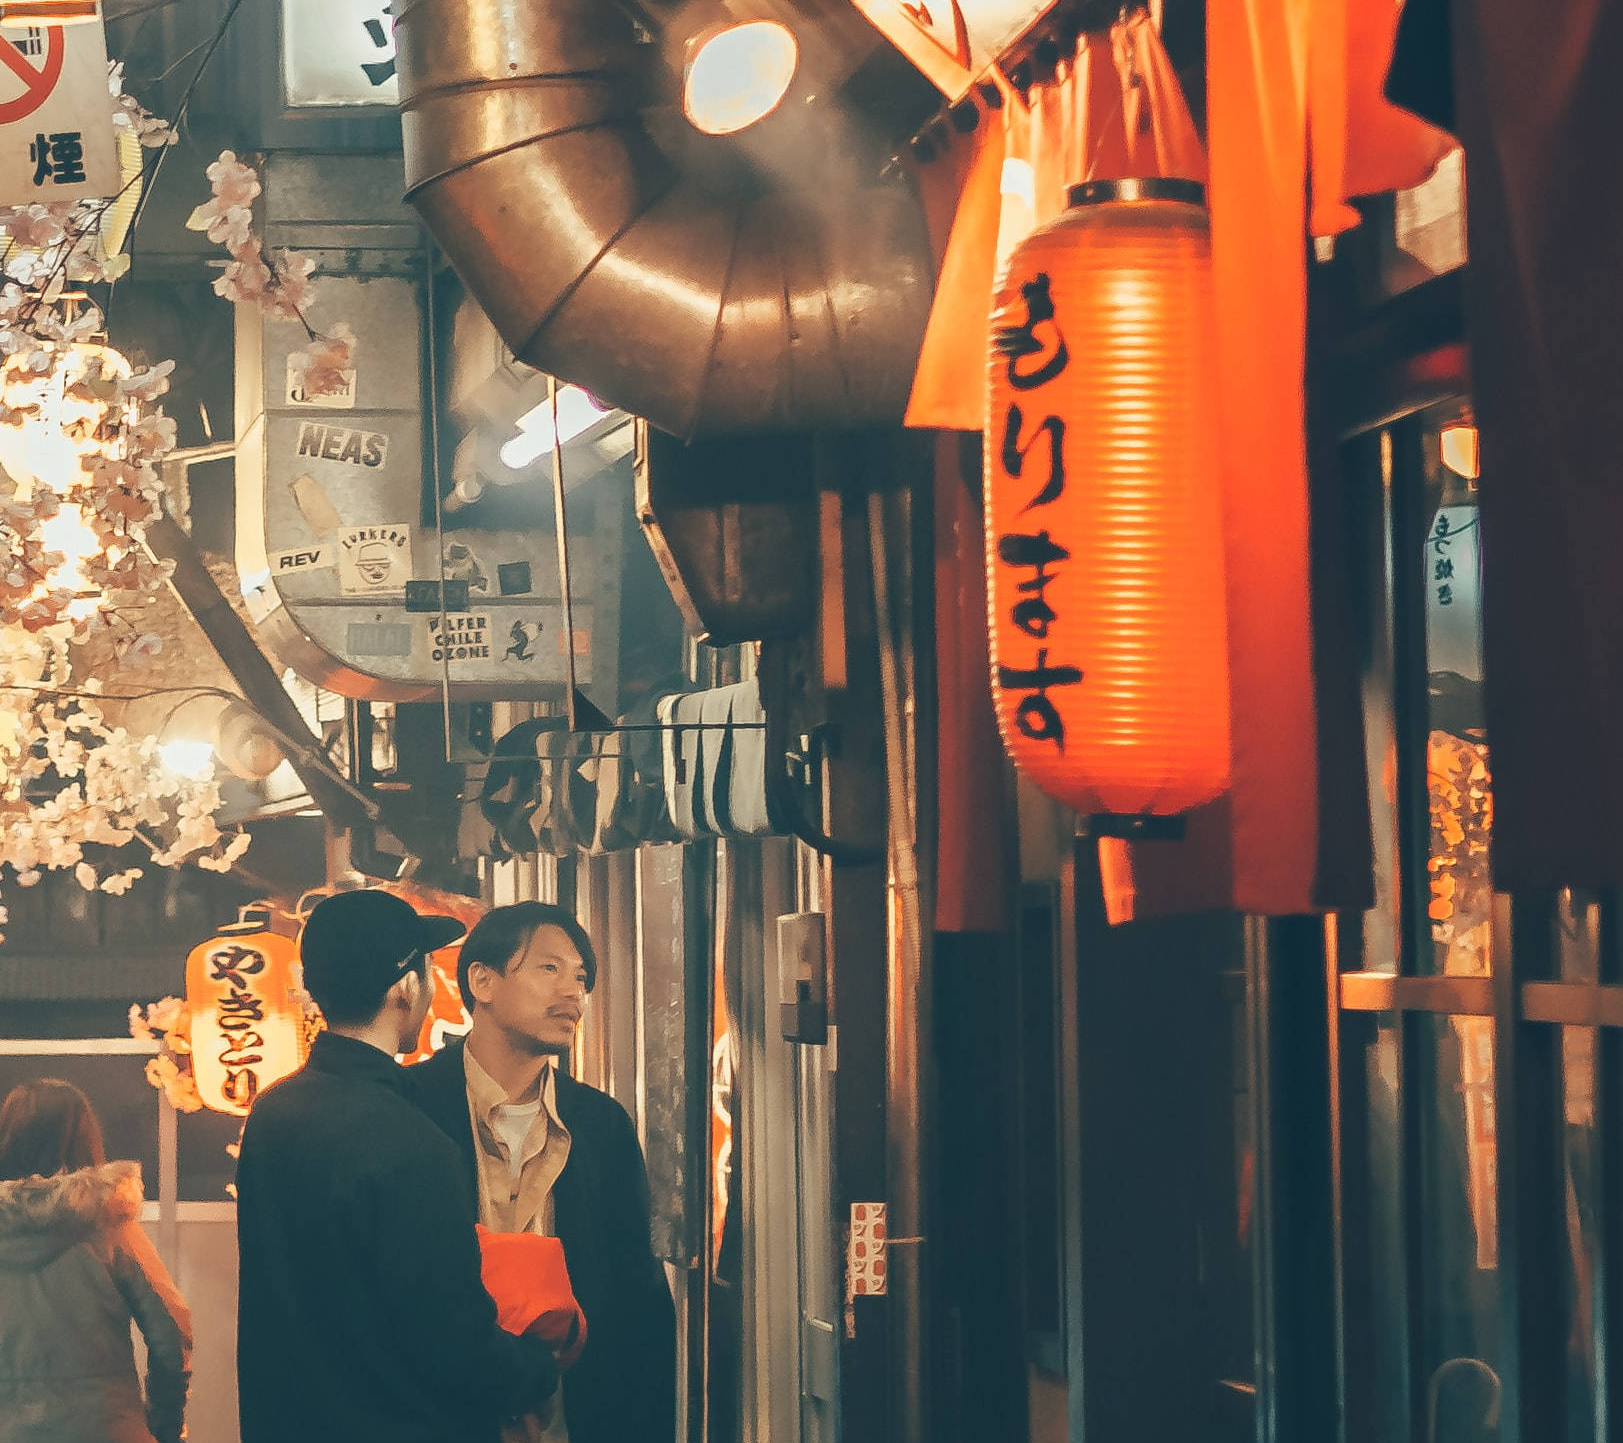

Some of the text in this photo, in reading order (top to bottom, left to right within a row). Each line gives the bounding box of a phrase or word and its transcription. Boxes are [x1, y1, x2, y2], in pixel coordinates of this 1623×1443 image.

[279, 550, 321, 569] REV
[429, 617, 487, 633] PLFER
[211, 946, 265, 1107] やきとり
